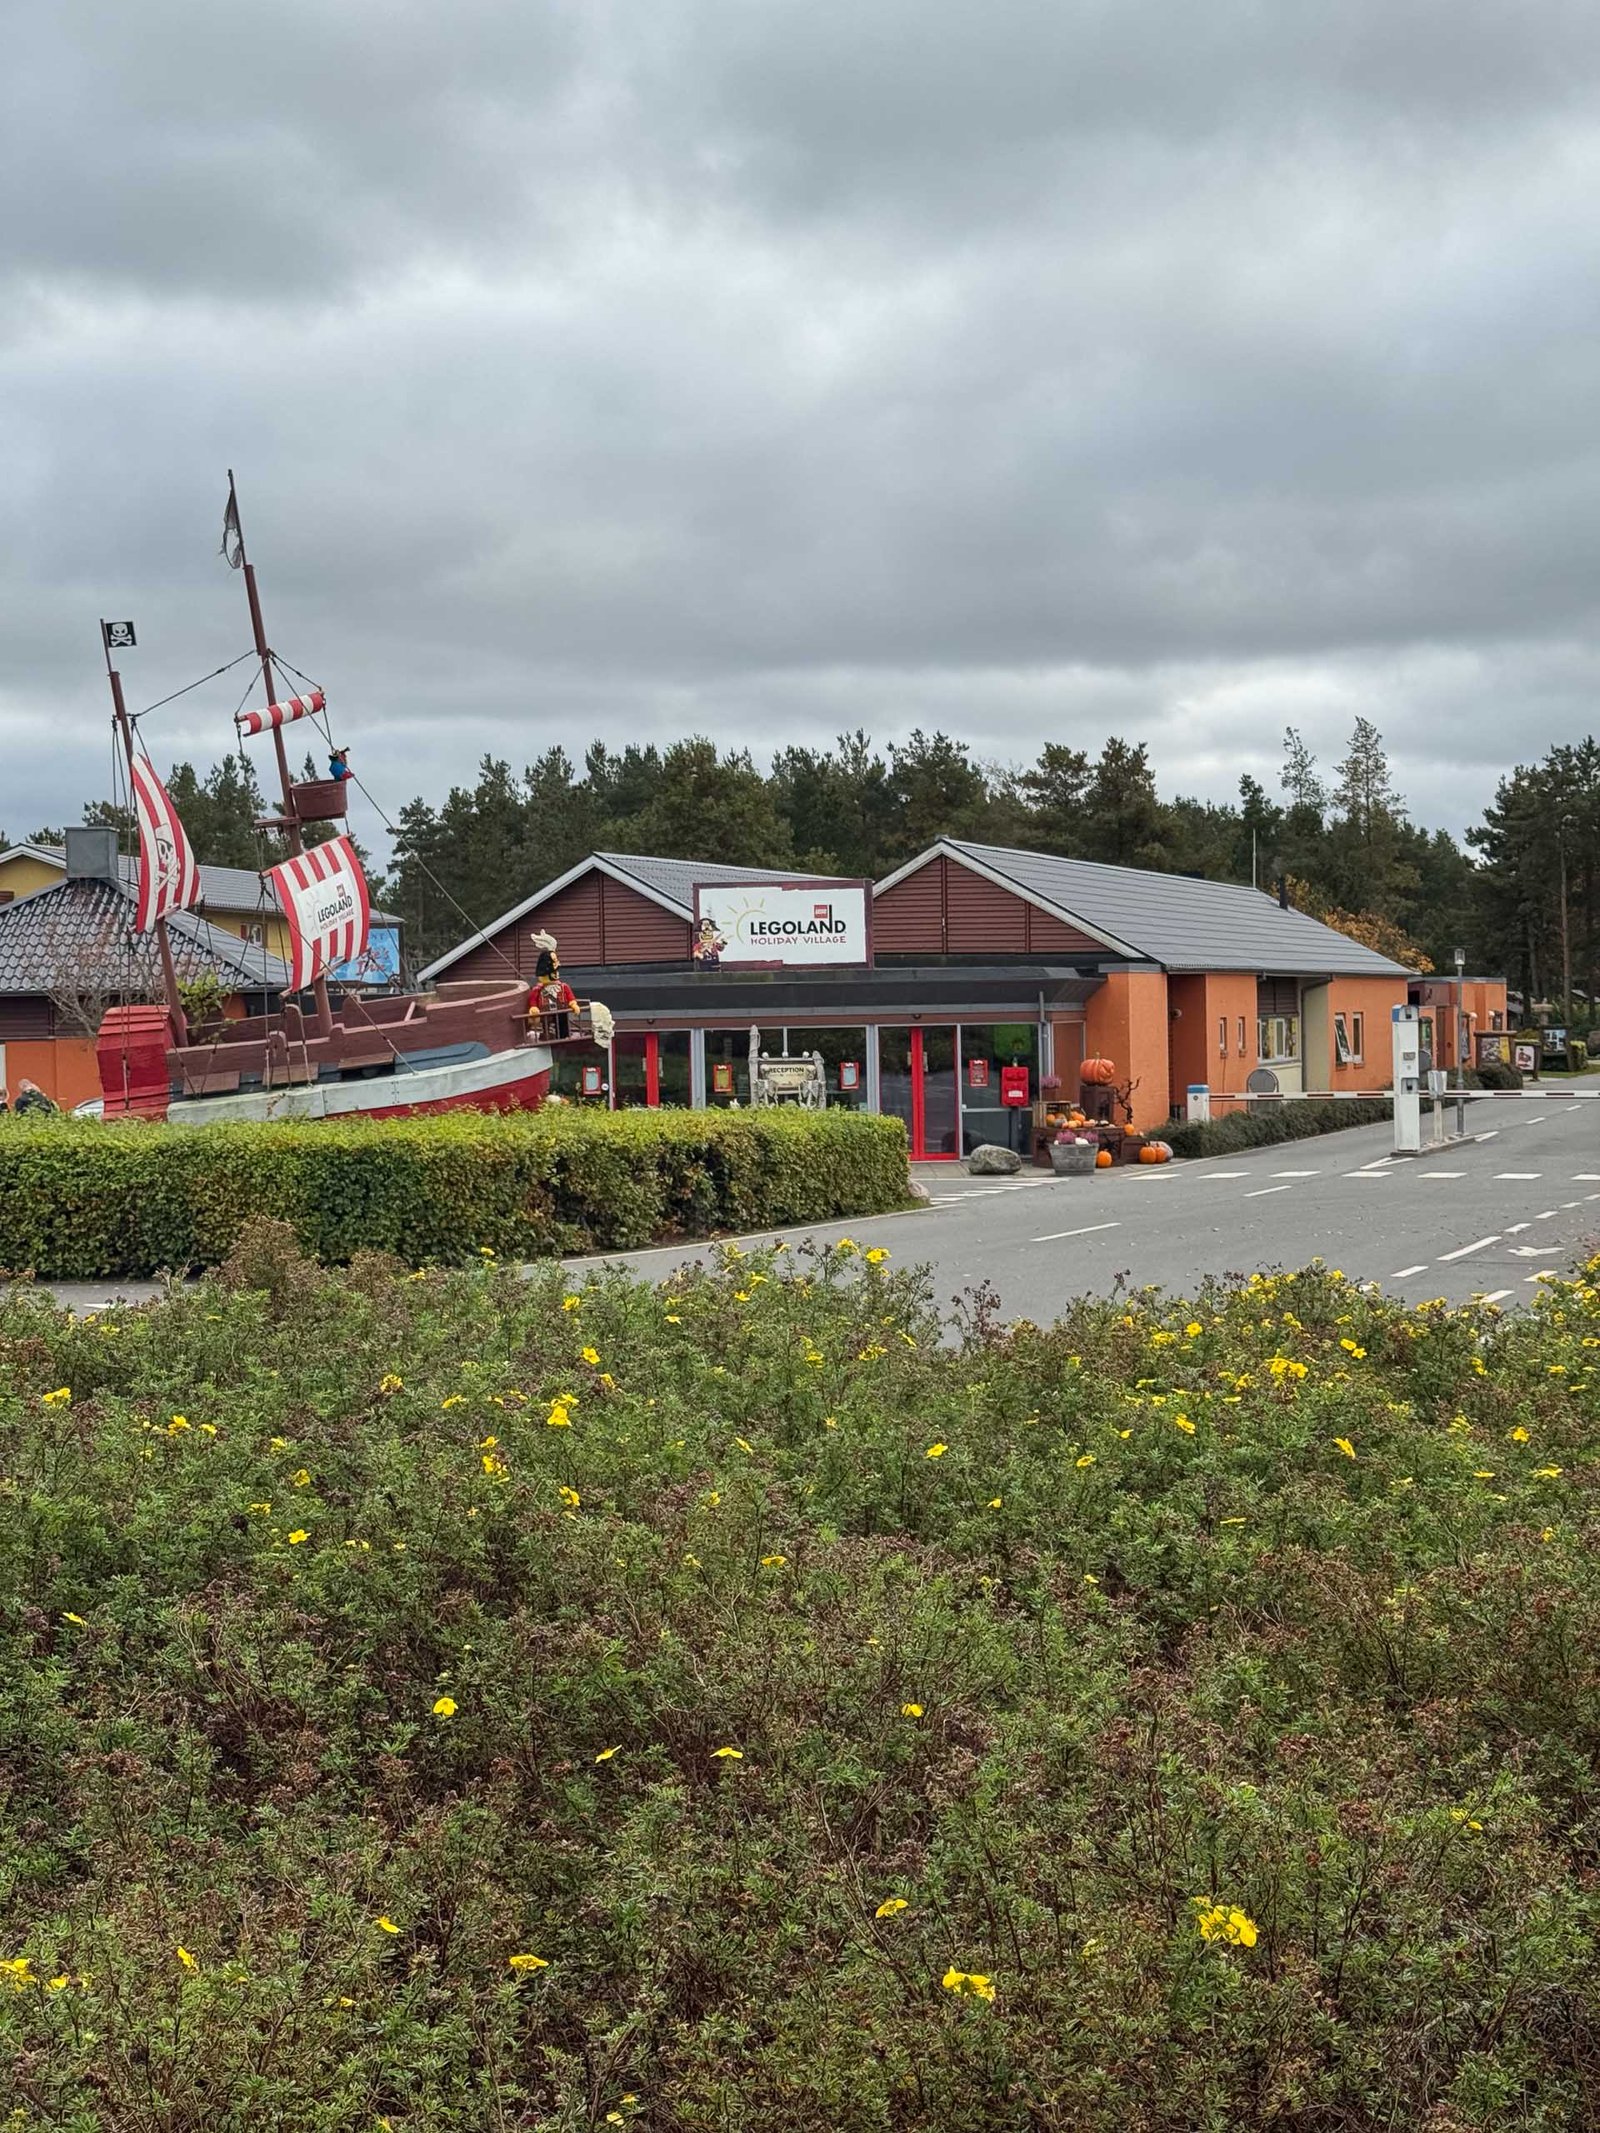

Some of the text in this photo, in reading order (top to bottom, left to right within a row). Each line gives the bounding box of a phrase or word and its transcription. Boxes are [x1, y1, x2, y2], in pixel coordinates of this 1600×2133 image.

[317, 884, 353, 923] LEGOLAND
[750, 904, 847, 935] LEGOLAND
[750, 936, 847, 945] HOLIDAY VILLAGE
